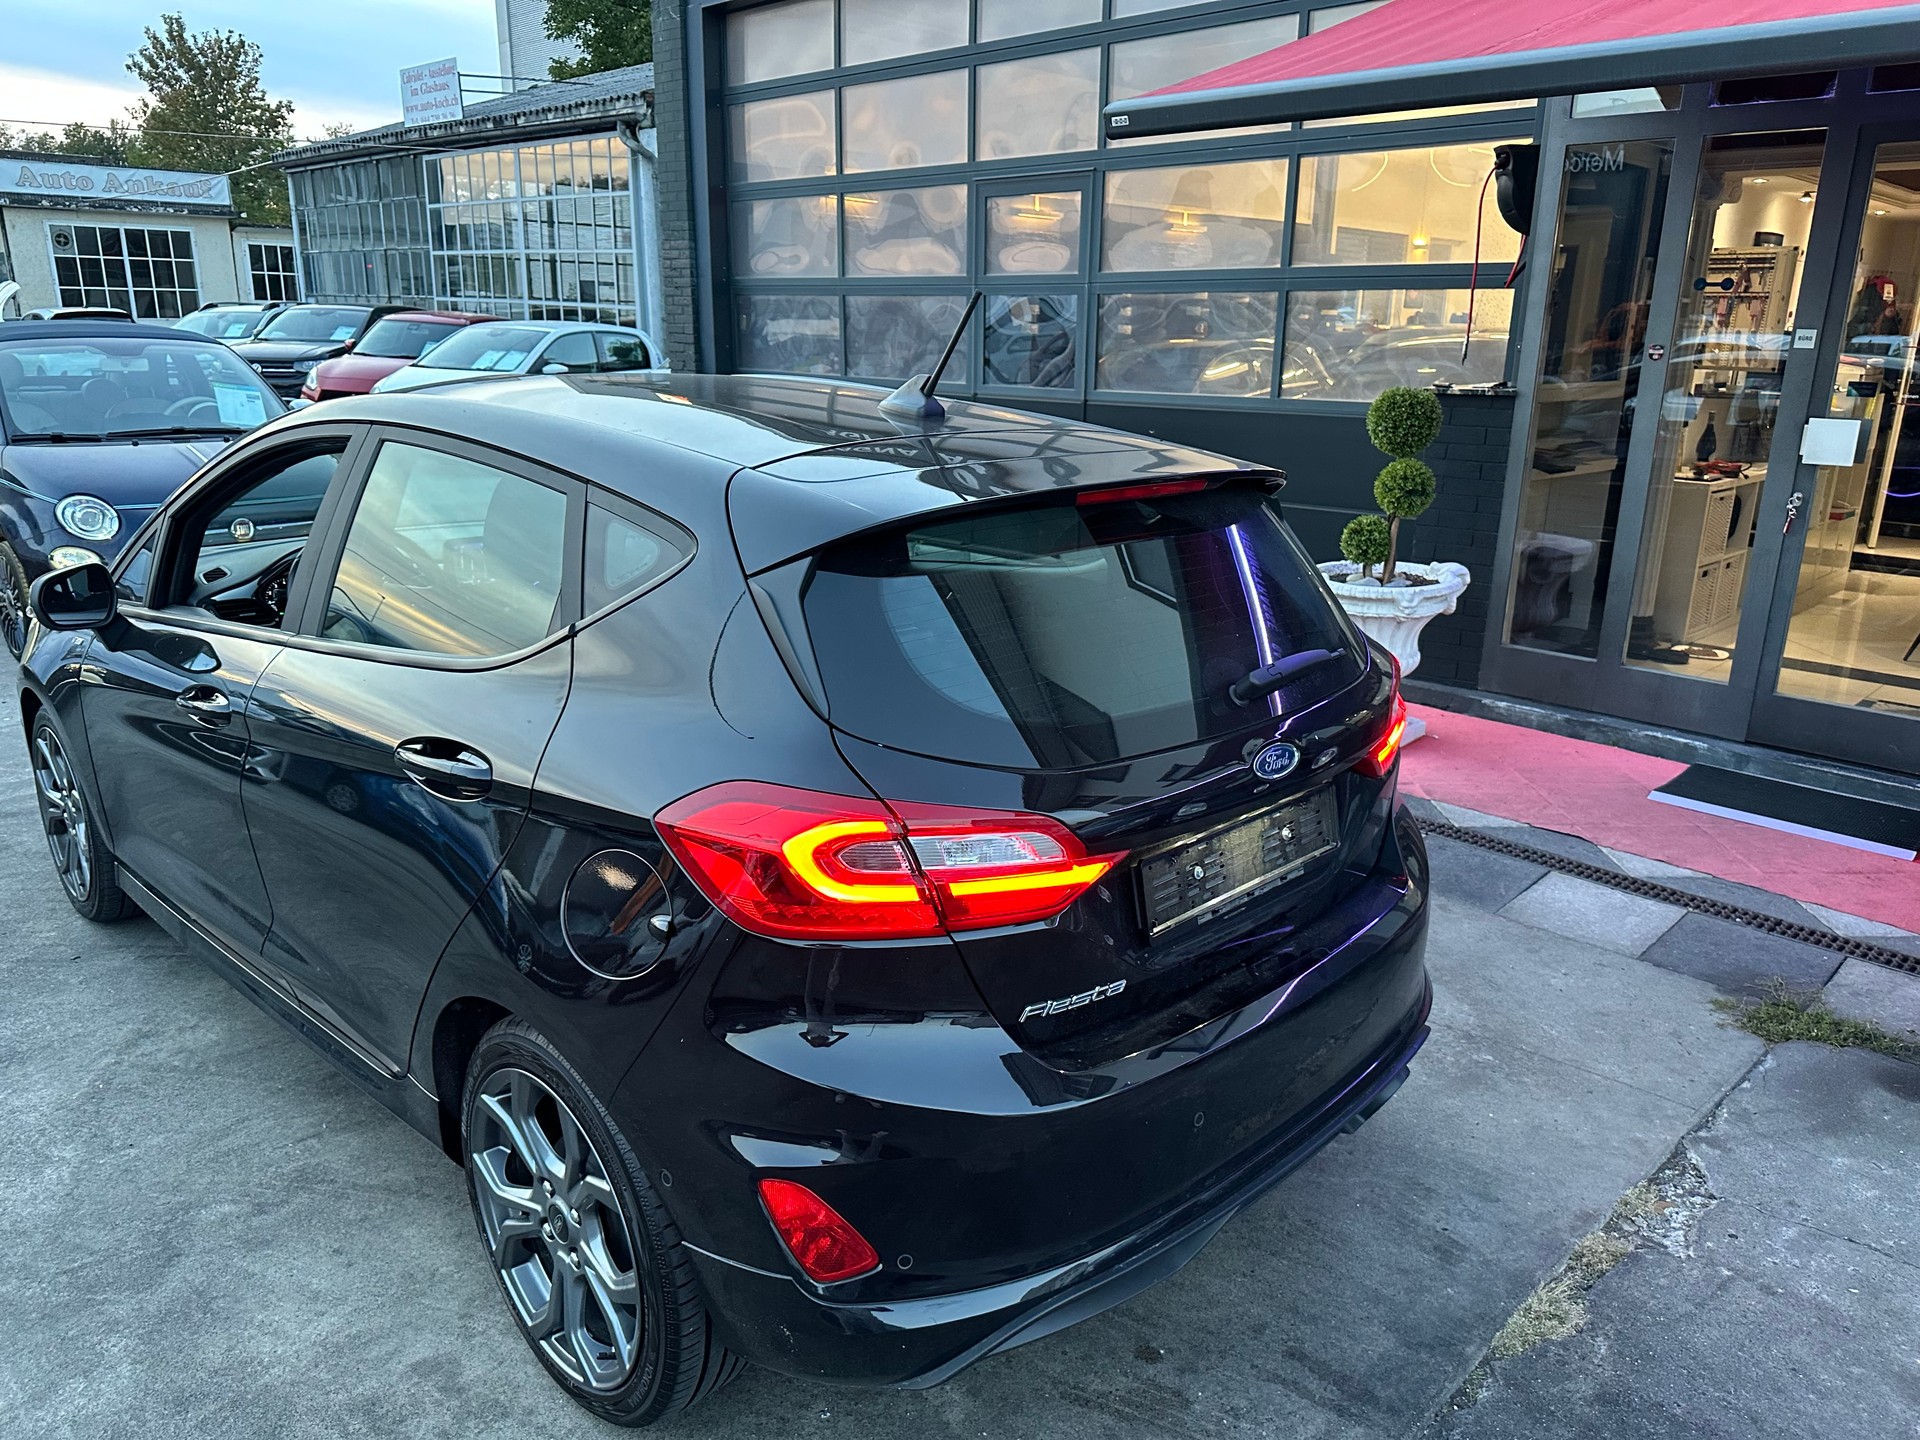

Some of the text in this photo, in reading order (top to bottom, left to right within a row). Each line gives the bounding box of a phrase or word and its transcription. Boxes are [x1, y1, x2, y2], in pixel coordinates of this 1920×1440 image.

[410, 80, 449, 96] im Glashaus
[405, 94, 459, 112] www.auto-koch.ch
[16, 166, 213, 199] Auto Ankauf
[1264, 749, 1290, 772] Ford
[1018, 979, 1127, 1023] Fiesta
